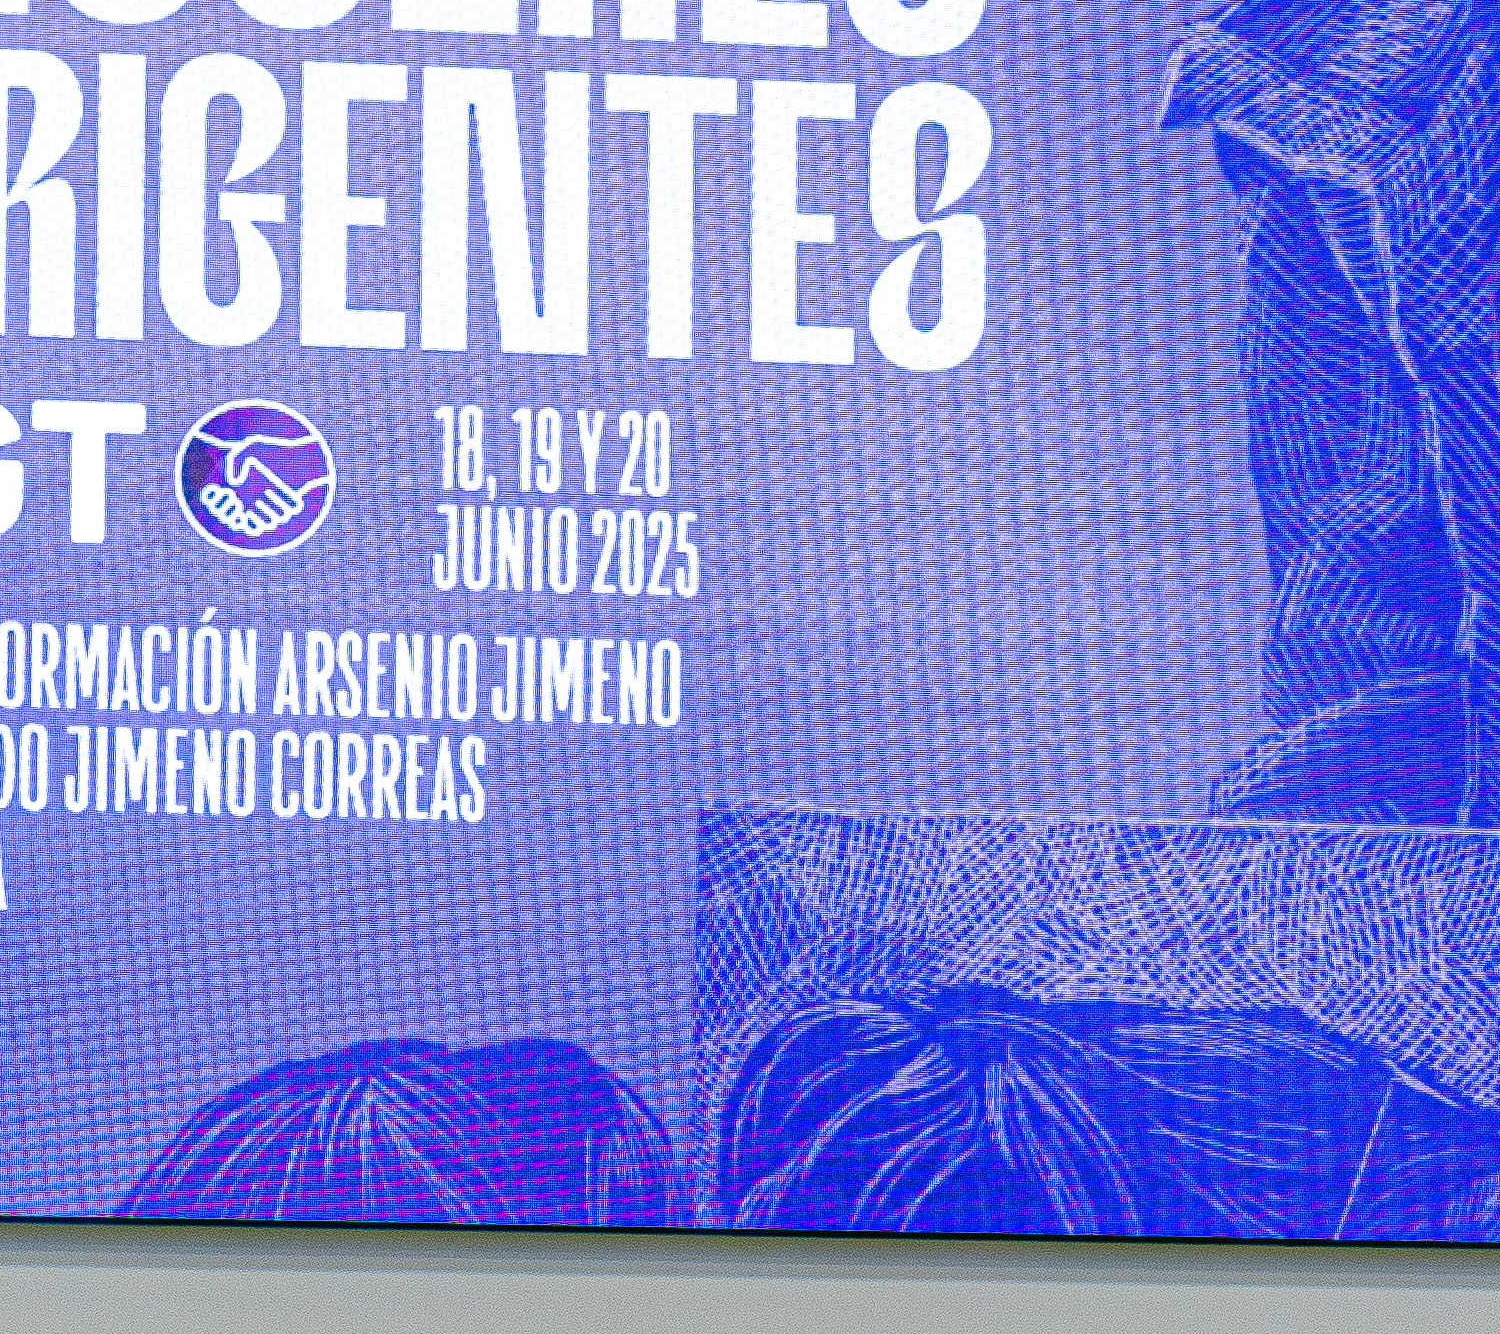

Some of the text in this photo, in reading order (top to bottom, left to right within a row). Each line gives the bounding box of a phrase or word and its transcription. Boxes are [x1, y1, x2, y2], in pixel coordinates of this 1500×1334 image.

[434, 405, 670, 502] 18, 19 Y 20
[433, 503, 699, 598] JUNIO 2025
[273, 630, 477, 721] ARSENIO
[491, 637, 681, 727] JIMENO
[65, 726, 255, 817] JIMENO
[271, 730, 485, 823] CORREAS
